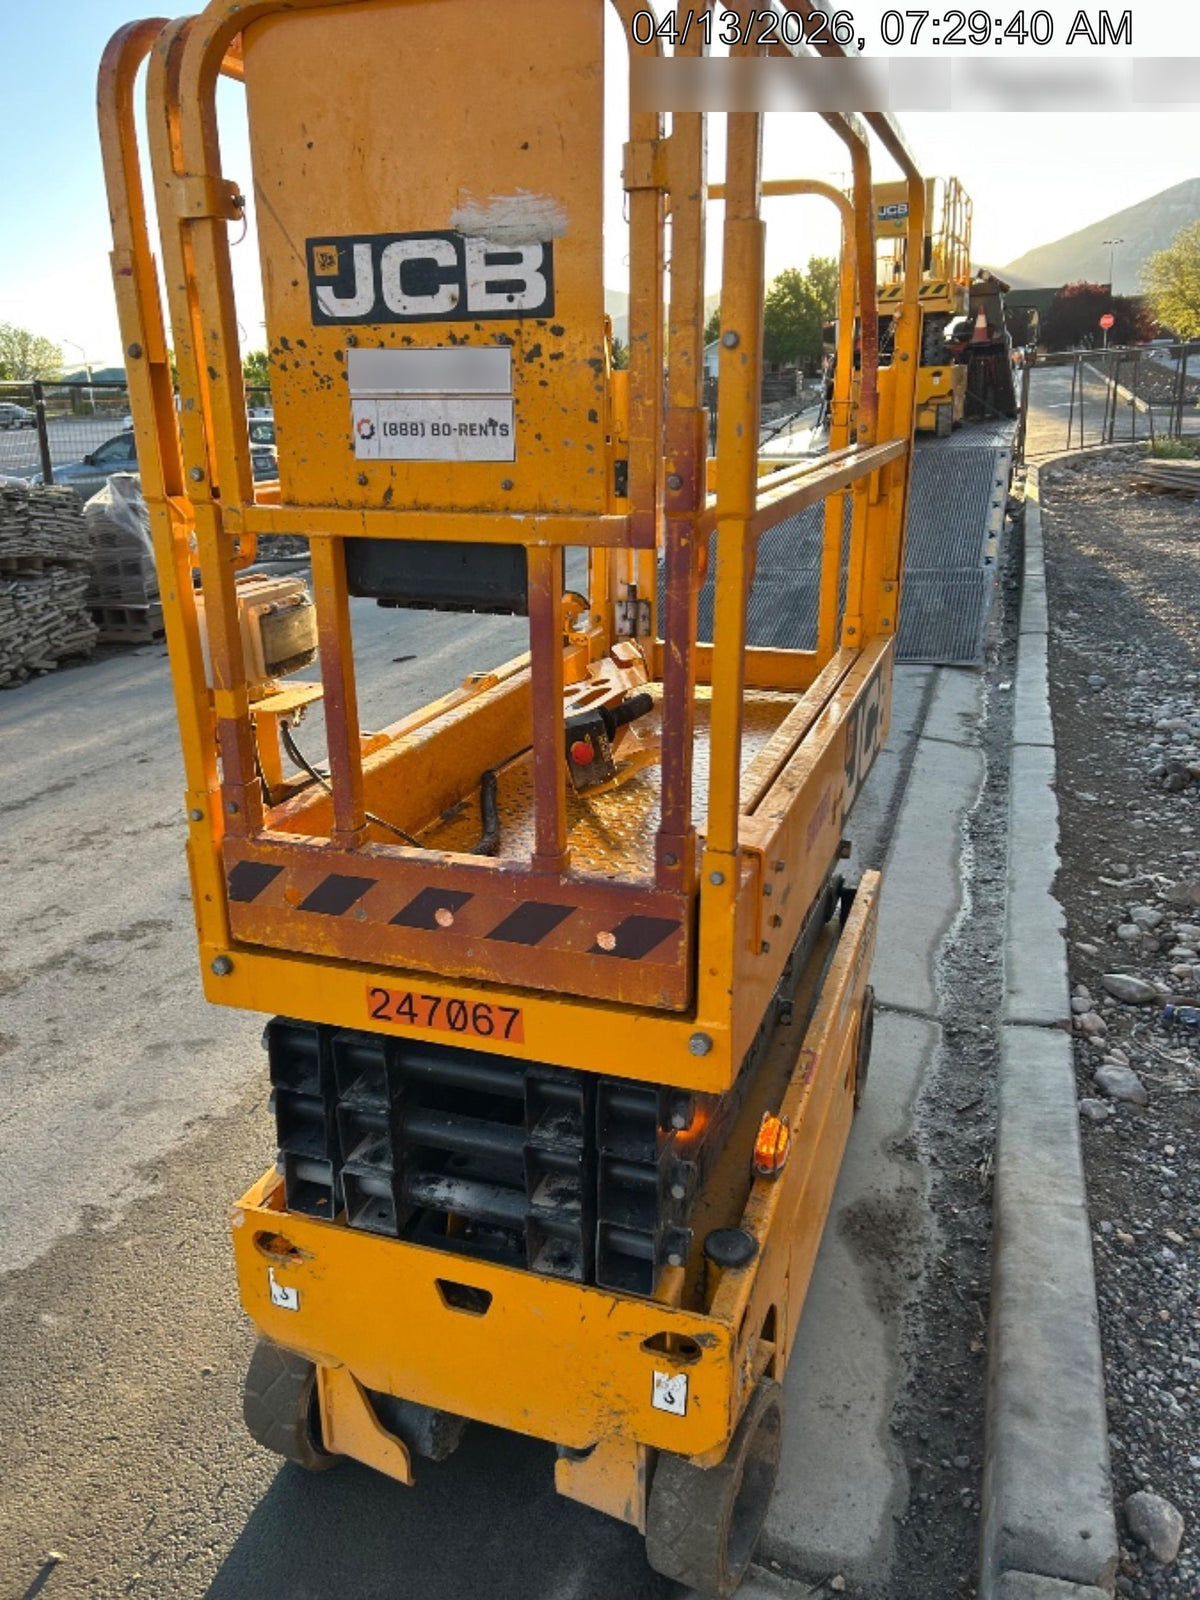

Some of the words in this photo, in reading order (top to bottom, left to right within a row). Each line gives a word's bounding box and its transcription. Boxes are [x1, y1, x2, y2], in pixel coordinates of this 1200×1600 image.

[878, 203, 908, 216] JCB
[315, 237, 547, 317] JCB
[383, 422, 426, 437] (888)
[370, 988, 520, 1039] 247067
